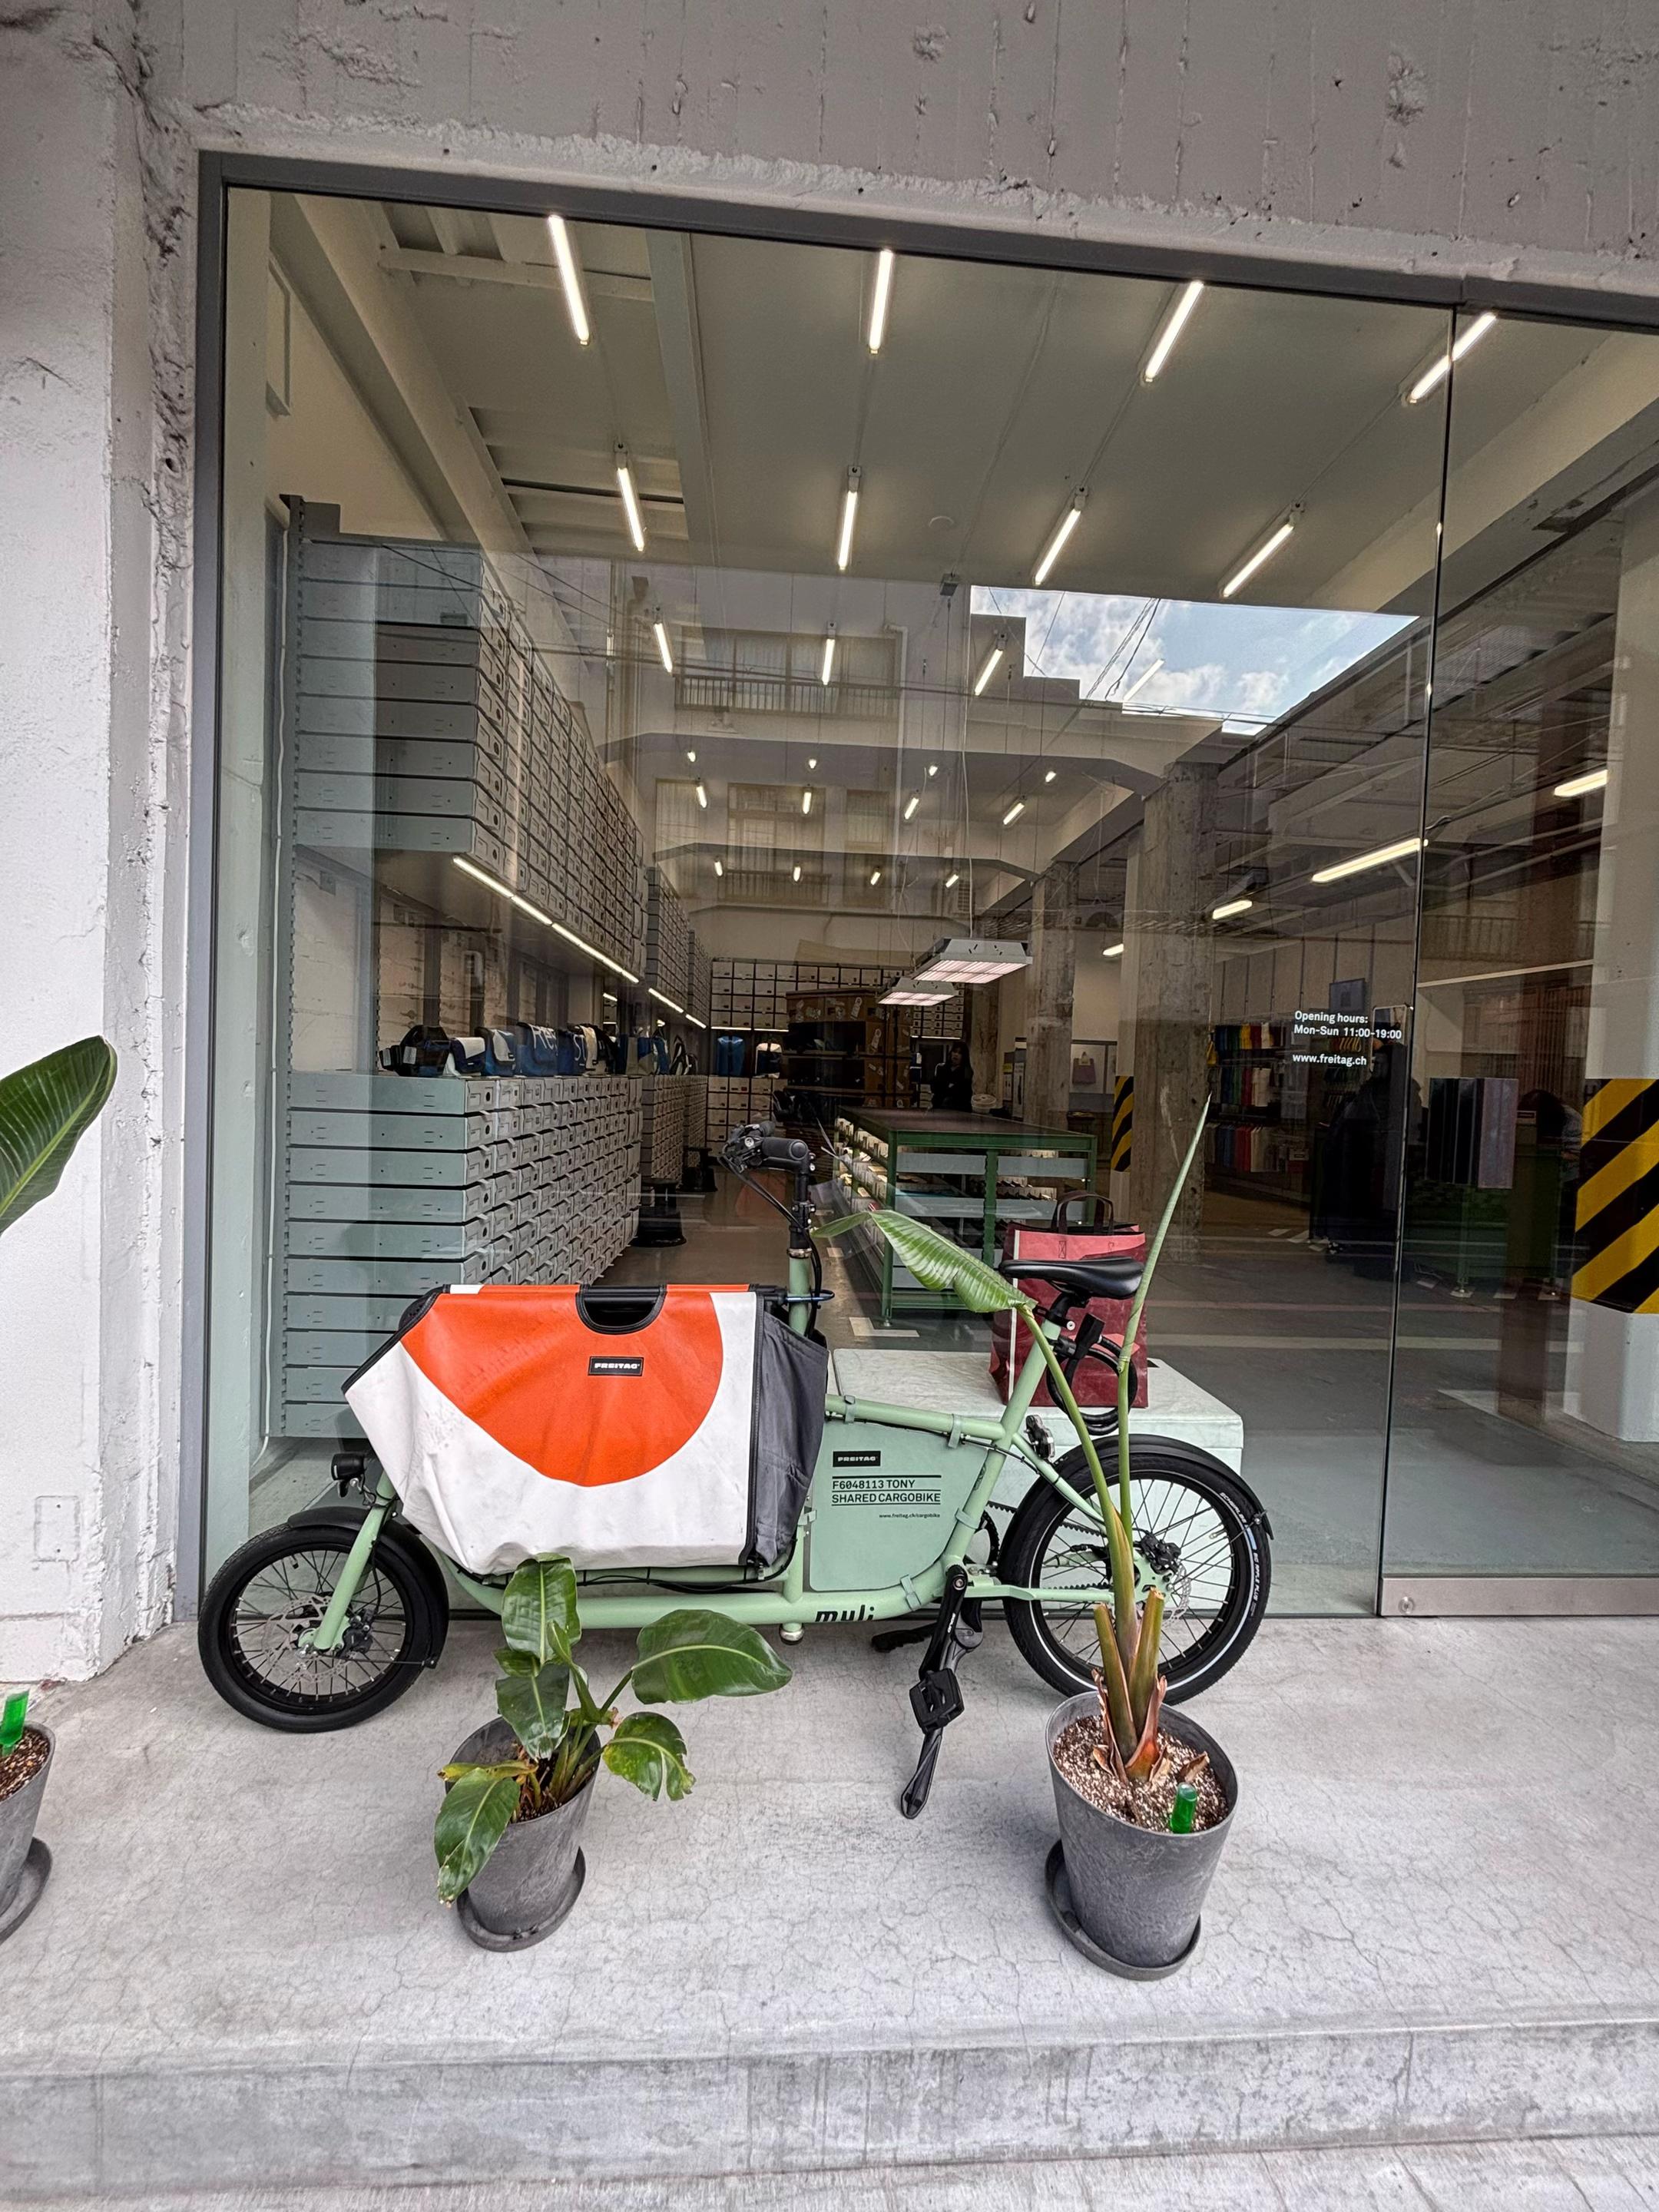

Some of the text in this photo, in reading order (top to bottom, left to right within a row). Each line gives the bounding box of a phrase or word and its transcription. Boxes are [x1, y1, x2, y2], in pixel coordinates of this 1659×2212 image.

[1294, 1011, 1369, 1024] Opening hours:
[1293, 1025, 1402, 1039] Mon-Sun 11:00-19:00
[1293, 1053, 1367, 1068] www.freitag.ch
[886, 1479, 916, 1489] TONY
[832, 1492, 941, 1503] SHARED CARGOBIKE
[815, 1604, 875, 1622] muli
